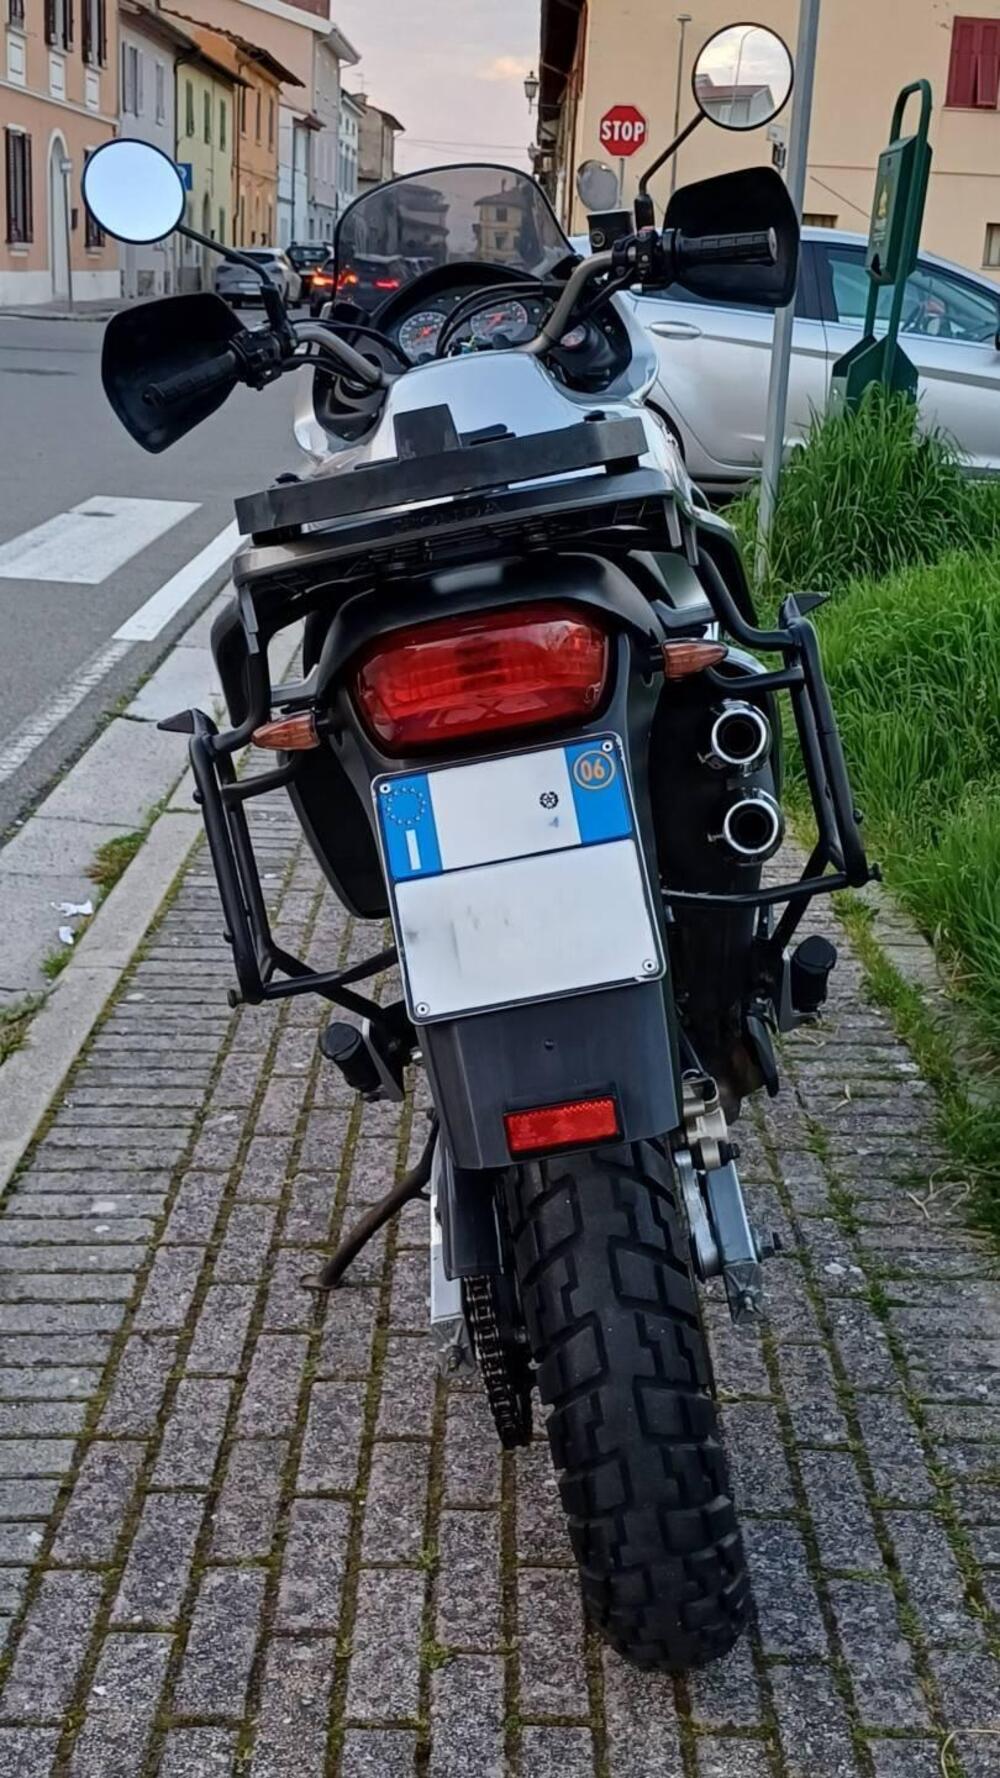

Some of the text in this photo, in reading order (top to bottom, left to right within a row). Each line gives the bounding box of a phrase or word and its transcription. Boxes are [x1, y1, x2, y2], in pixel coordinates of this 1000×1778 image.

[601, 120, 645, 142] STOP
[580, 759, 605, 782] 06
[405, 829, 421, 870] I
